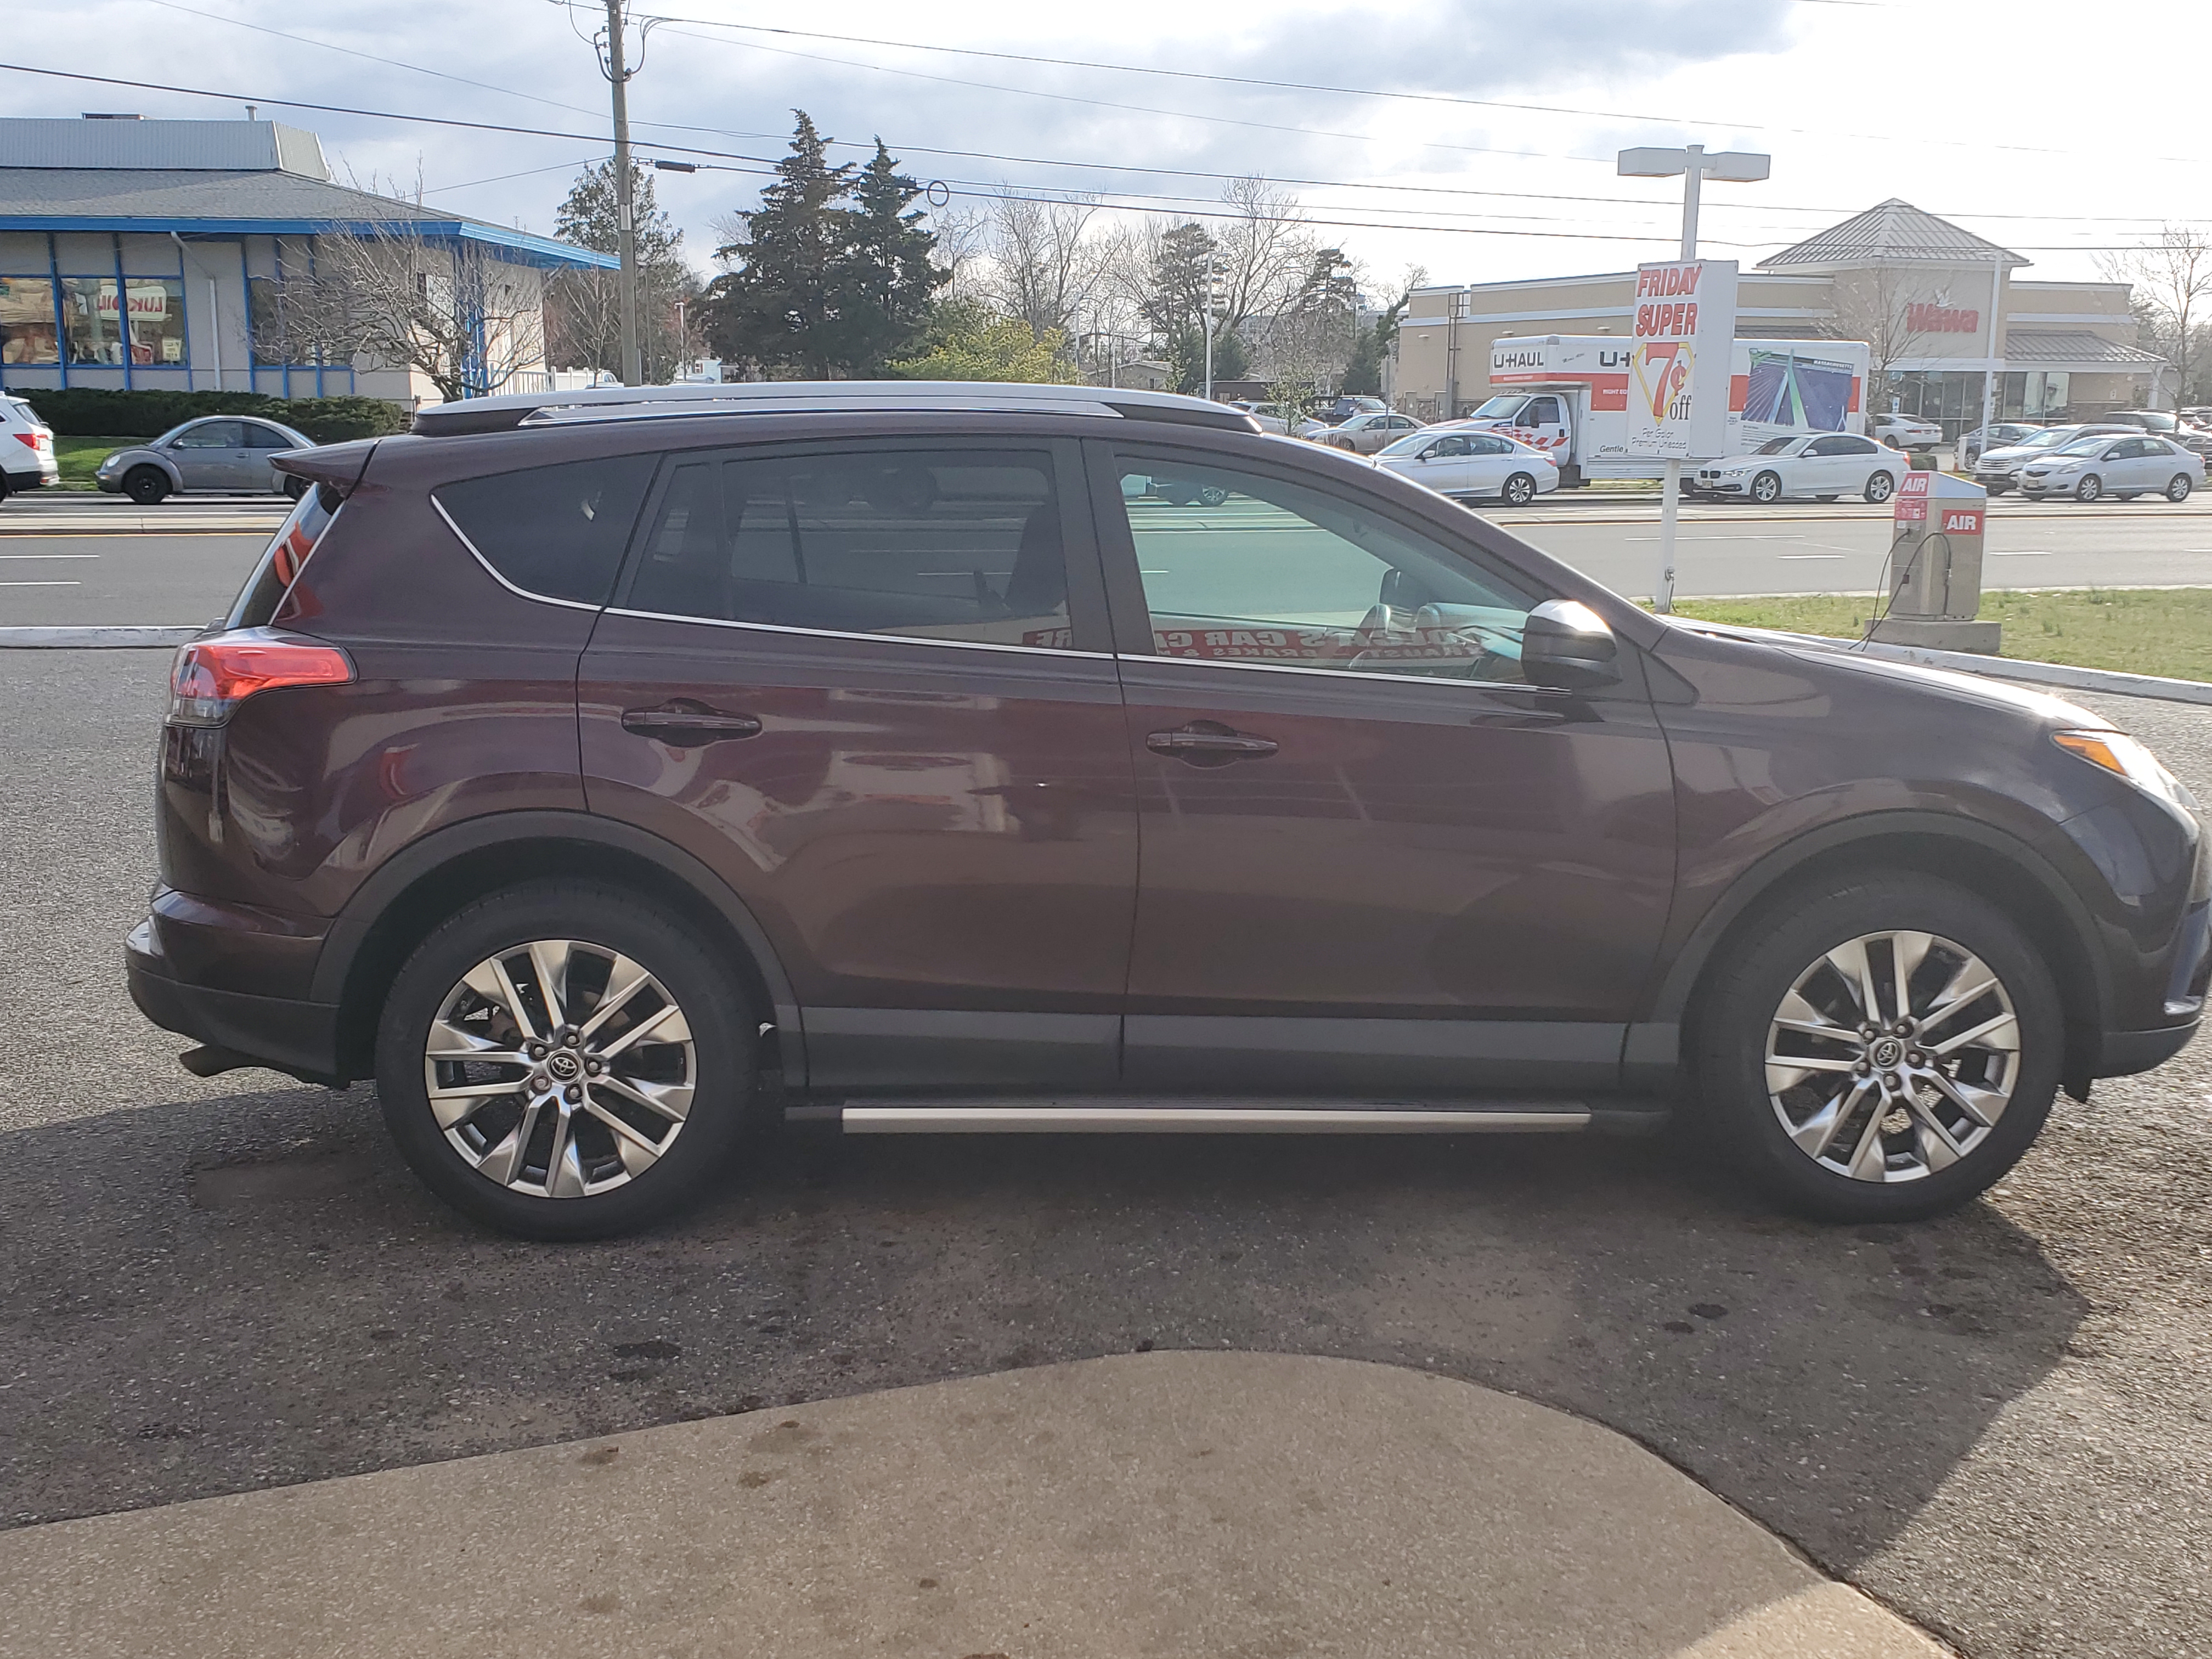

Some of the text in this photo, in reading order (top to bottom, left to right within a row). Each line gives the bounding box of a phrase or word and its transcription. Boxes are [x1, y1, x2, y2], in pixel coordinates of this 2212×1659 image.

[1637, 267, 1702, 297] FRIDAY
[1636, 303, 1697, 336] SUPER
[1907, 303, 1978, 332] Wawa
[1494, 352, 1544, 368] U-HAUL
[1669, 394, 1692, 420] off
[1599, 445, 1624, 453] Gentle
[1902, 478, 1927, 492] AIR
[1946, 515, 1977, 531] AIR
